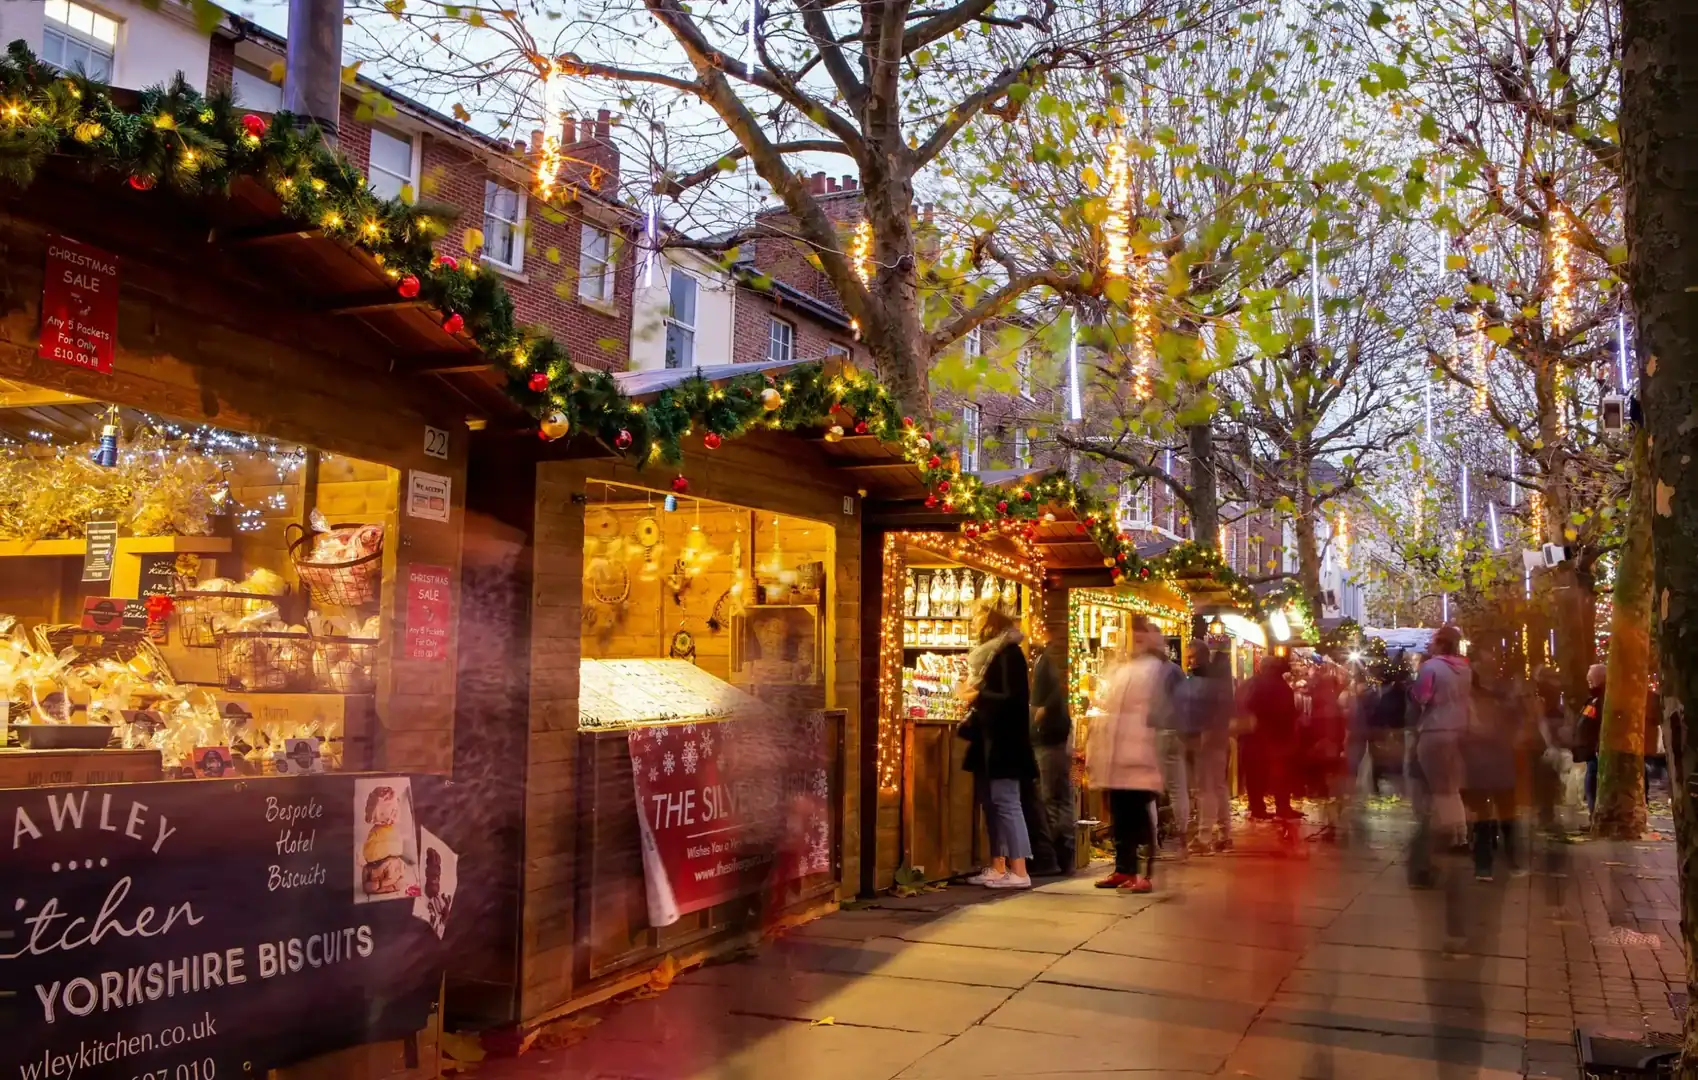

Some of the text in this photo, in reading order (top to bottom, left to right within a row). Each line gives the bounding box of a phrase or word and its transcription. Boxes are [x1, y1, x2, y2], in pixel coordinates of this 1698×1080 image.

[48, 246, 117, 276] CHRISTMAS
[63, 270, 100, 293] SALE
[47, 315, 110, 341] Any 5 Packets
[54, 347, 89, 364] £10.00
[58, 332, 97, 354] For Only
[425, 429, 446, 456] 22
[410, 572, 449, 586] CHRISTMAS
[418, 588, 440, 602] SALE
[265, 796, 324, 827] Bespoke
[652, 789, 696, 830] THE
[276, 829, 316, 856] Hotel
[686, 844, 711, 861] Wishes
[711, 840, 724, 855] You
[267, 862, 327, 892] Biscuits
[34, 925, 375, 1024] YORKSHIRE BISCUITS
